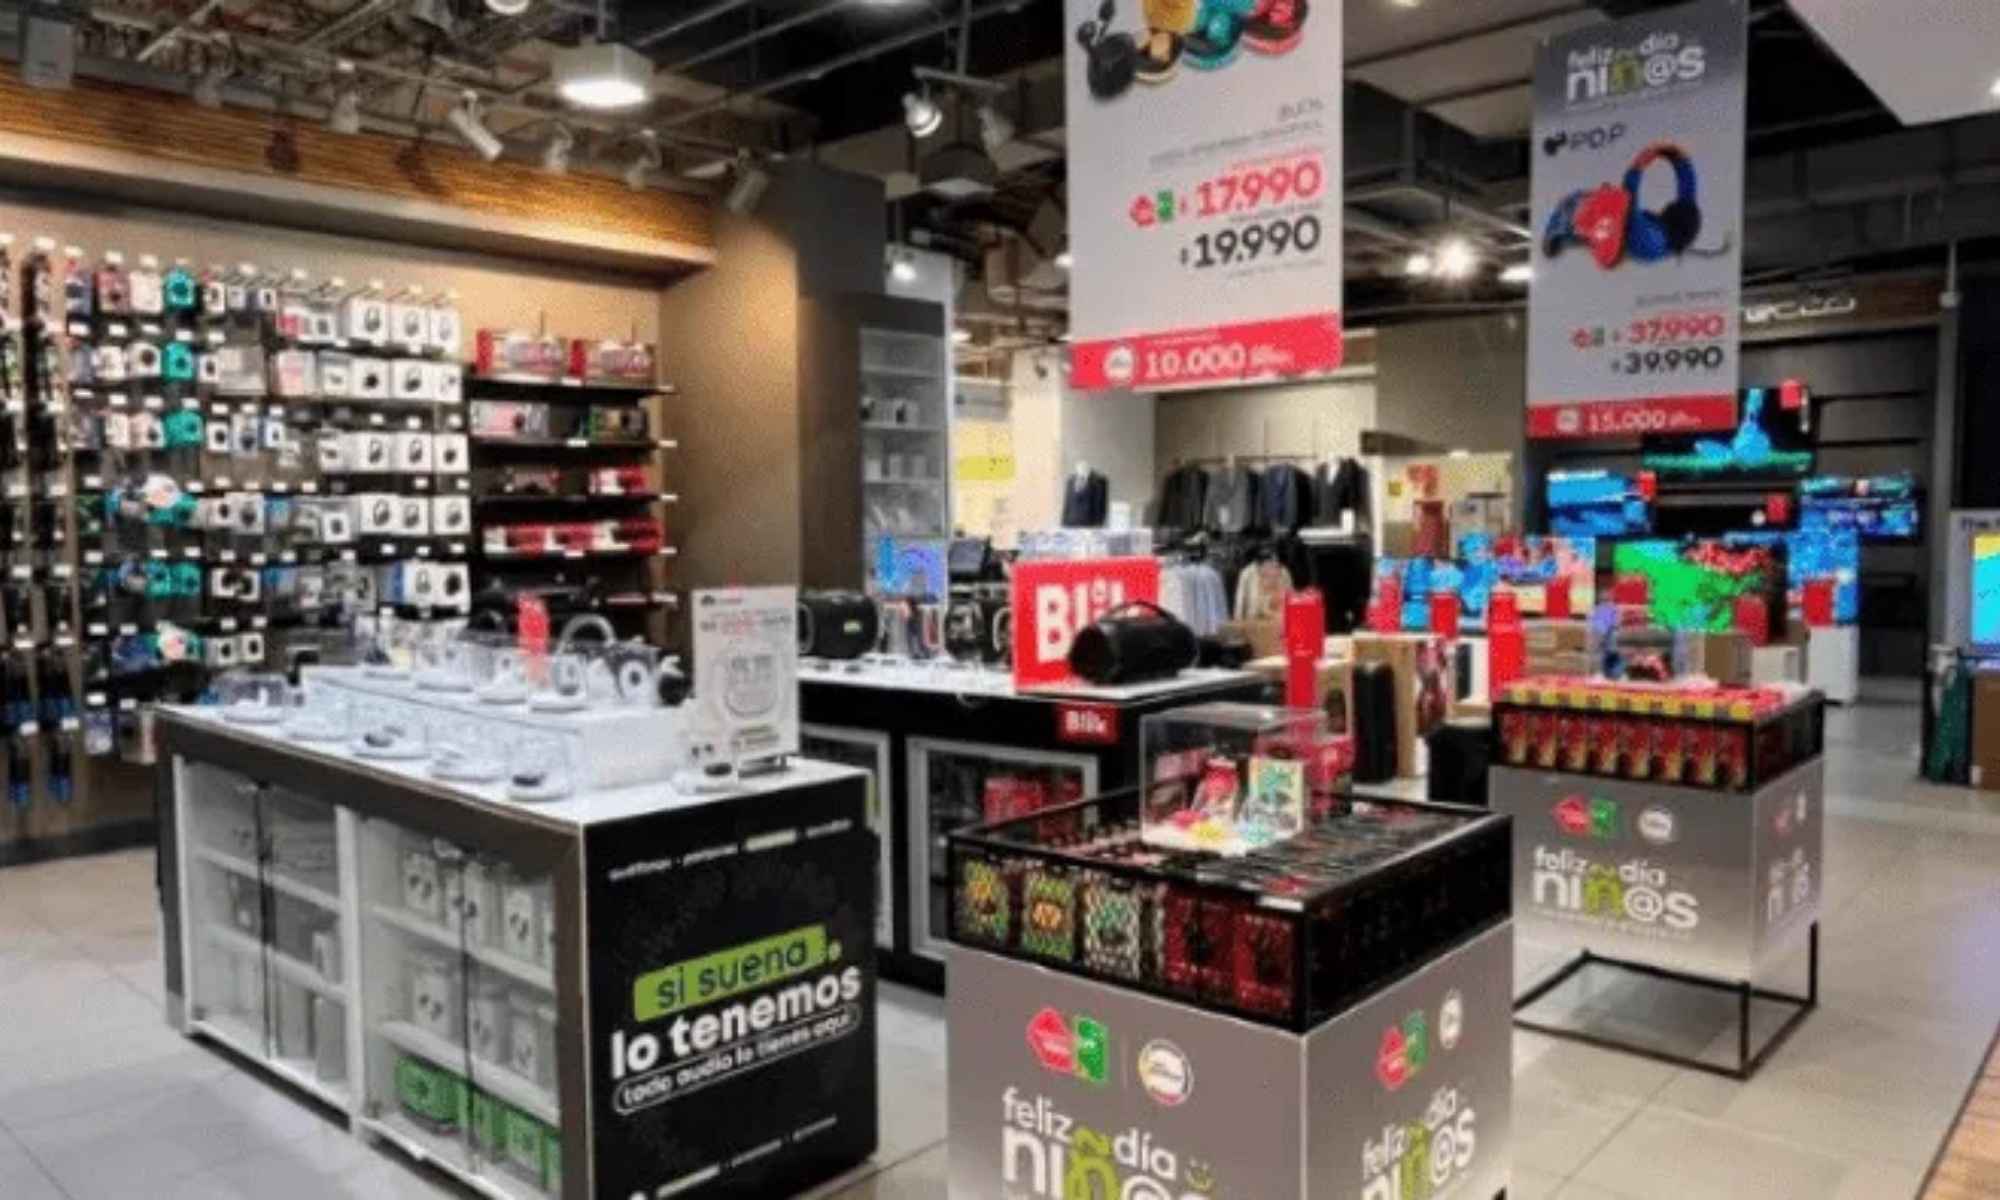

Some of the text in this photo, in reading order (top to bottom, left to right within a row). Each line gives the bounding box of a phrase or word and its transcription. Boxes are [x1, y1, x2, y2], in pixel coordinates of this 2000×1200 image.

[1196, 159, 1322, 219] 17.990
[1144, 342, 1246, 379] 10.000
[656, 965, 684, 1011] si
[610, 965, 862, 1080] lo tenemos
[1002, 1085, 1177, 1181] feliz día
